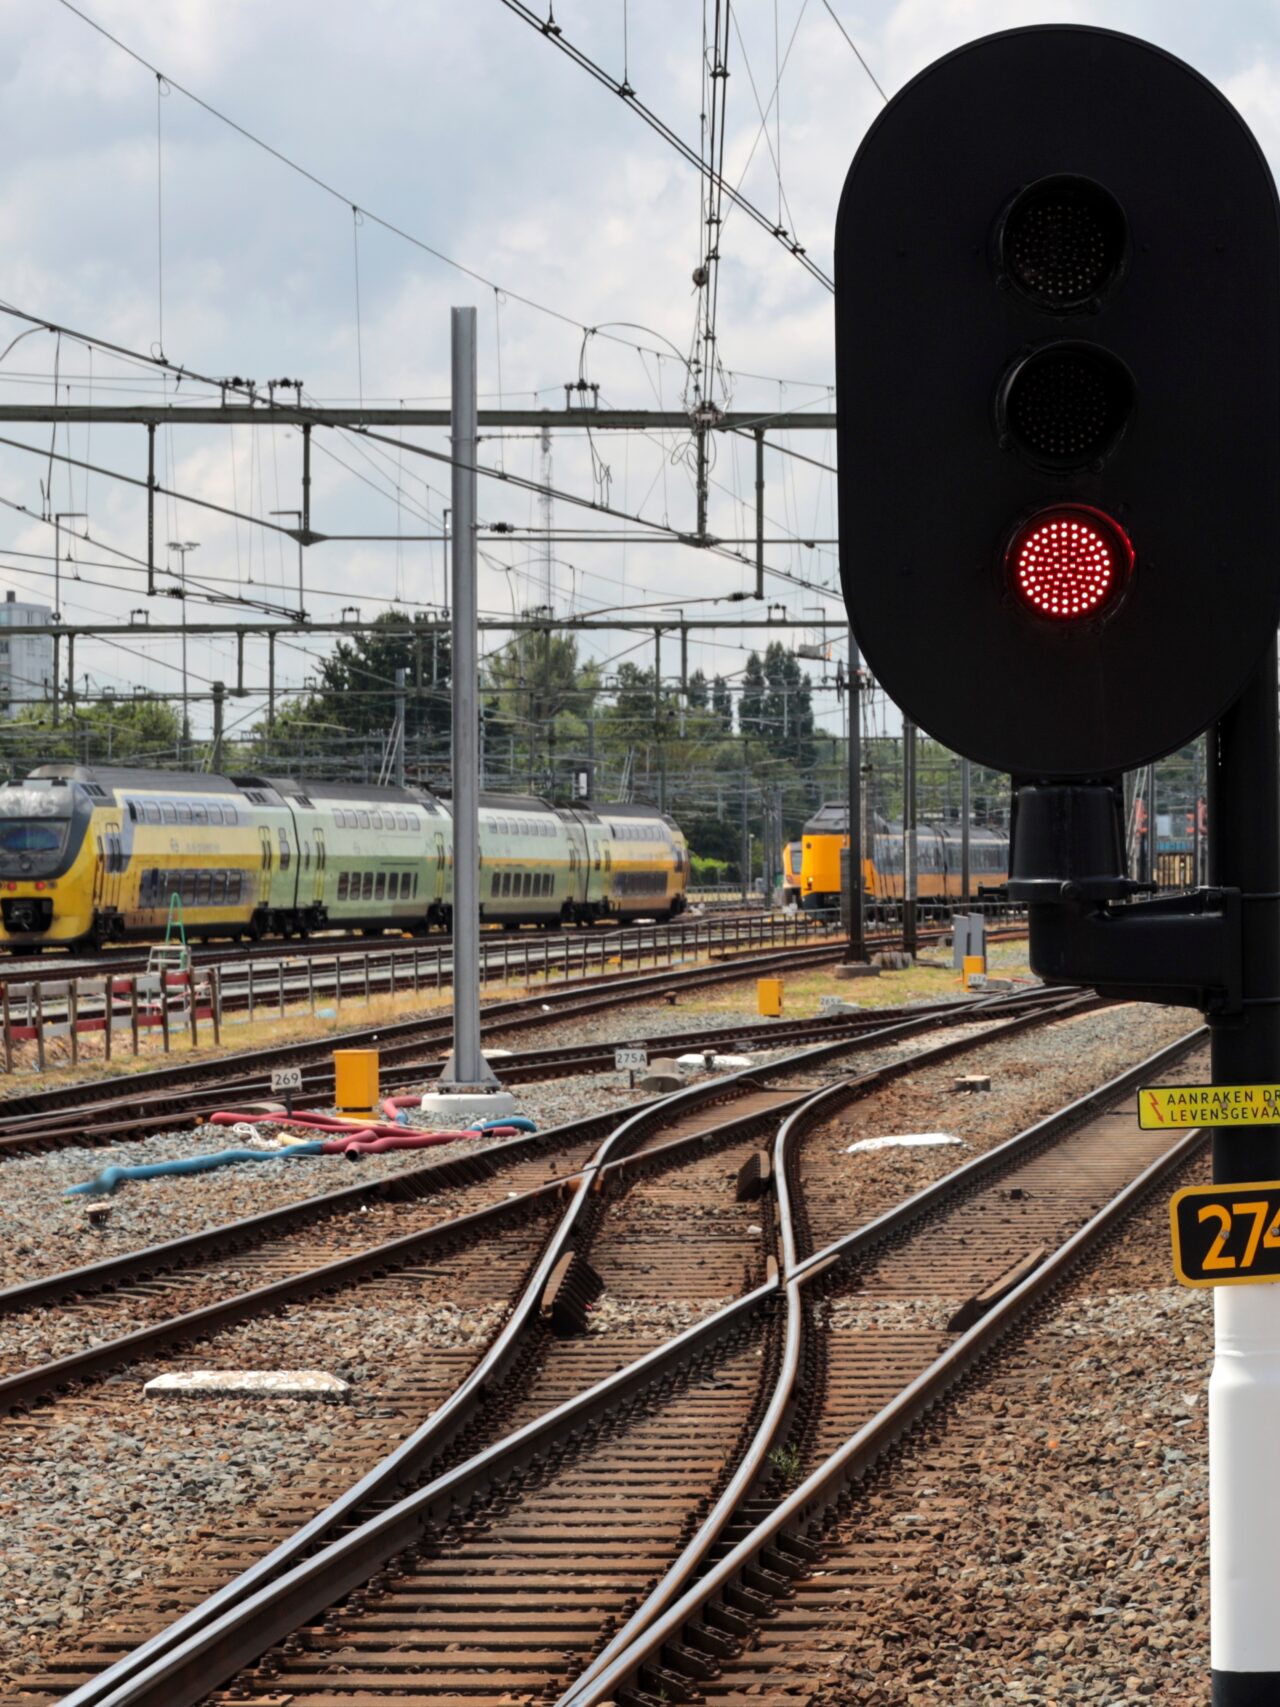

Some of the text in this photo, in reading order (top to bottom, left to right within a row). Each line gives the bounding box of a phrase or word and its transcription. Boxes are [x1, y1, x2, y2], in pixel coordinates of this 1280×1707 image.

[616, 1053, 646, 1063] 275A
[275, 1073, 299, 1085] 269
[1167, 1090, 1254, 1106] AANRAKEN
